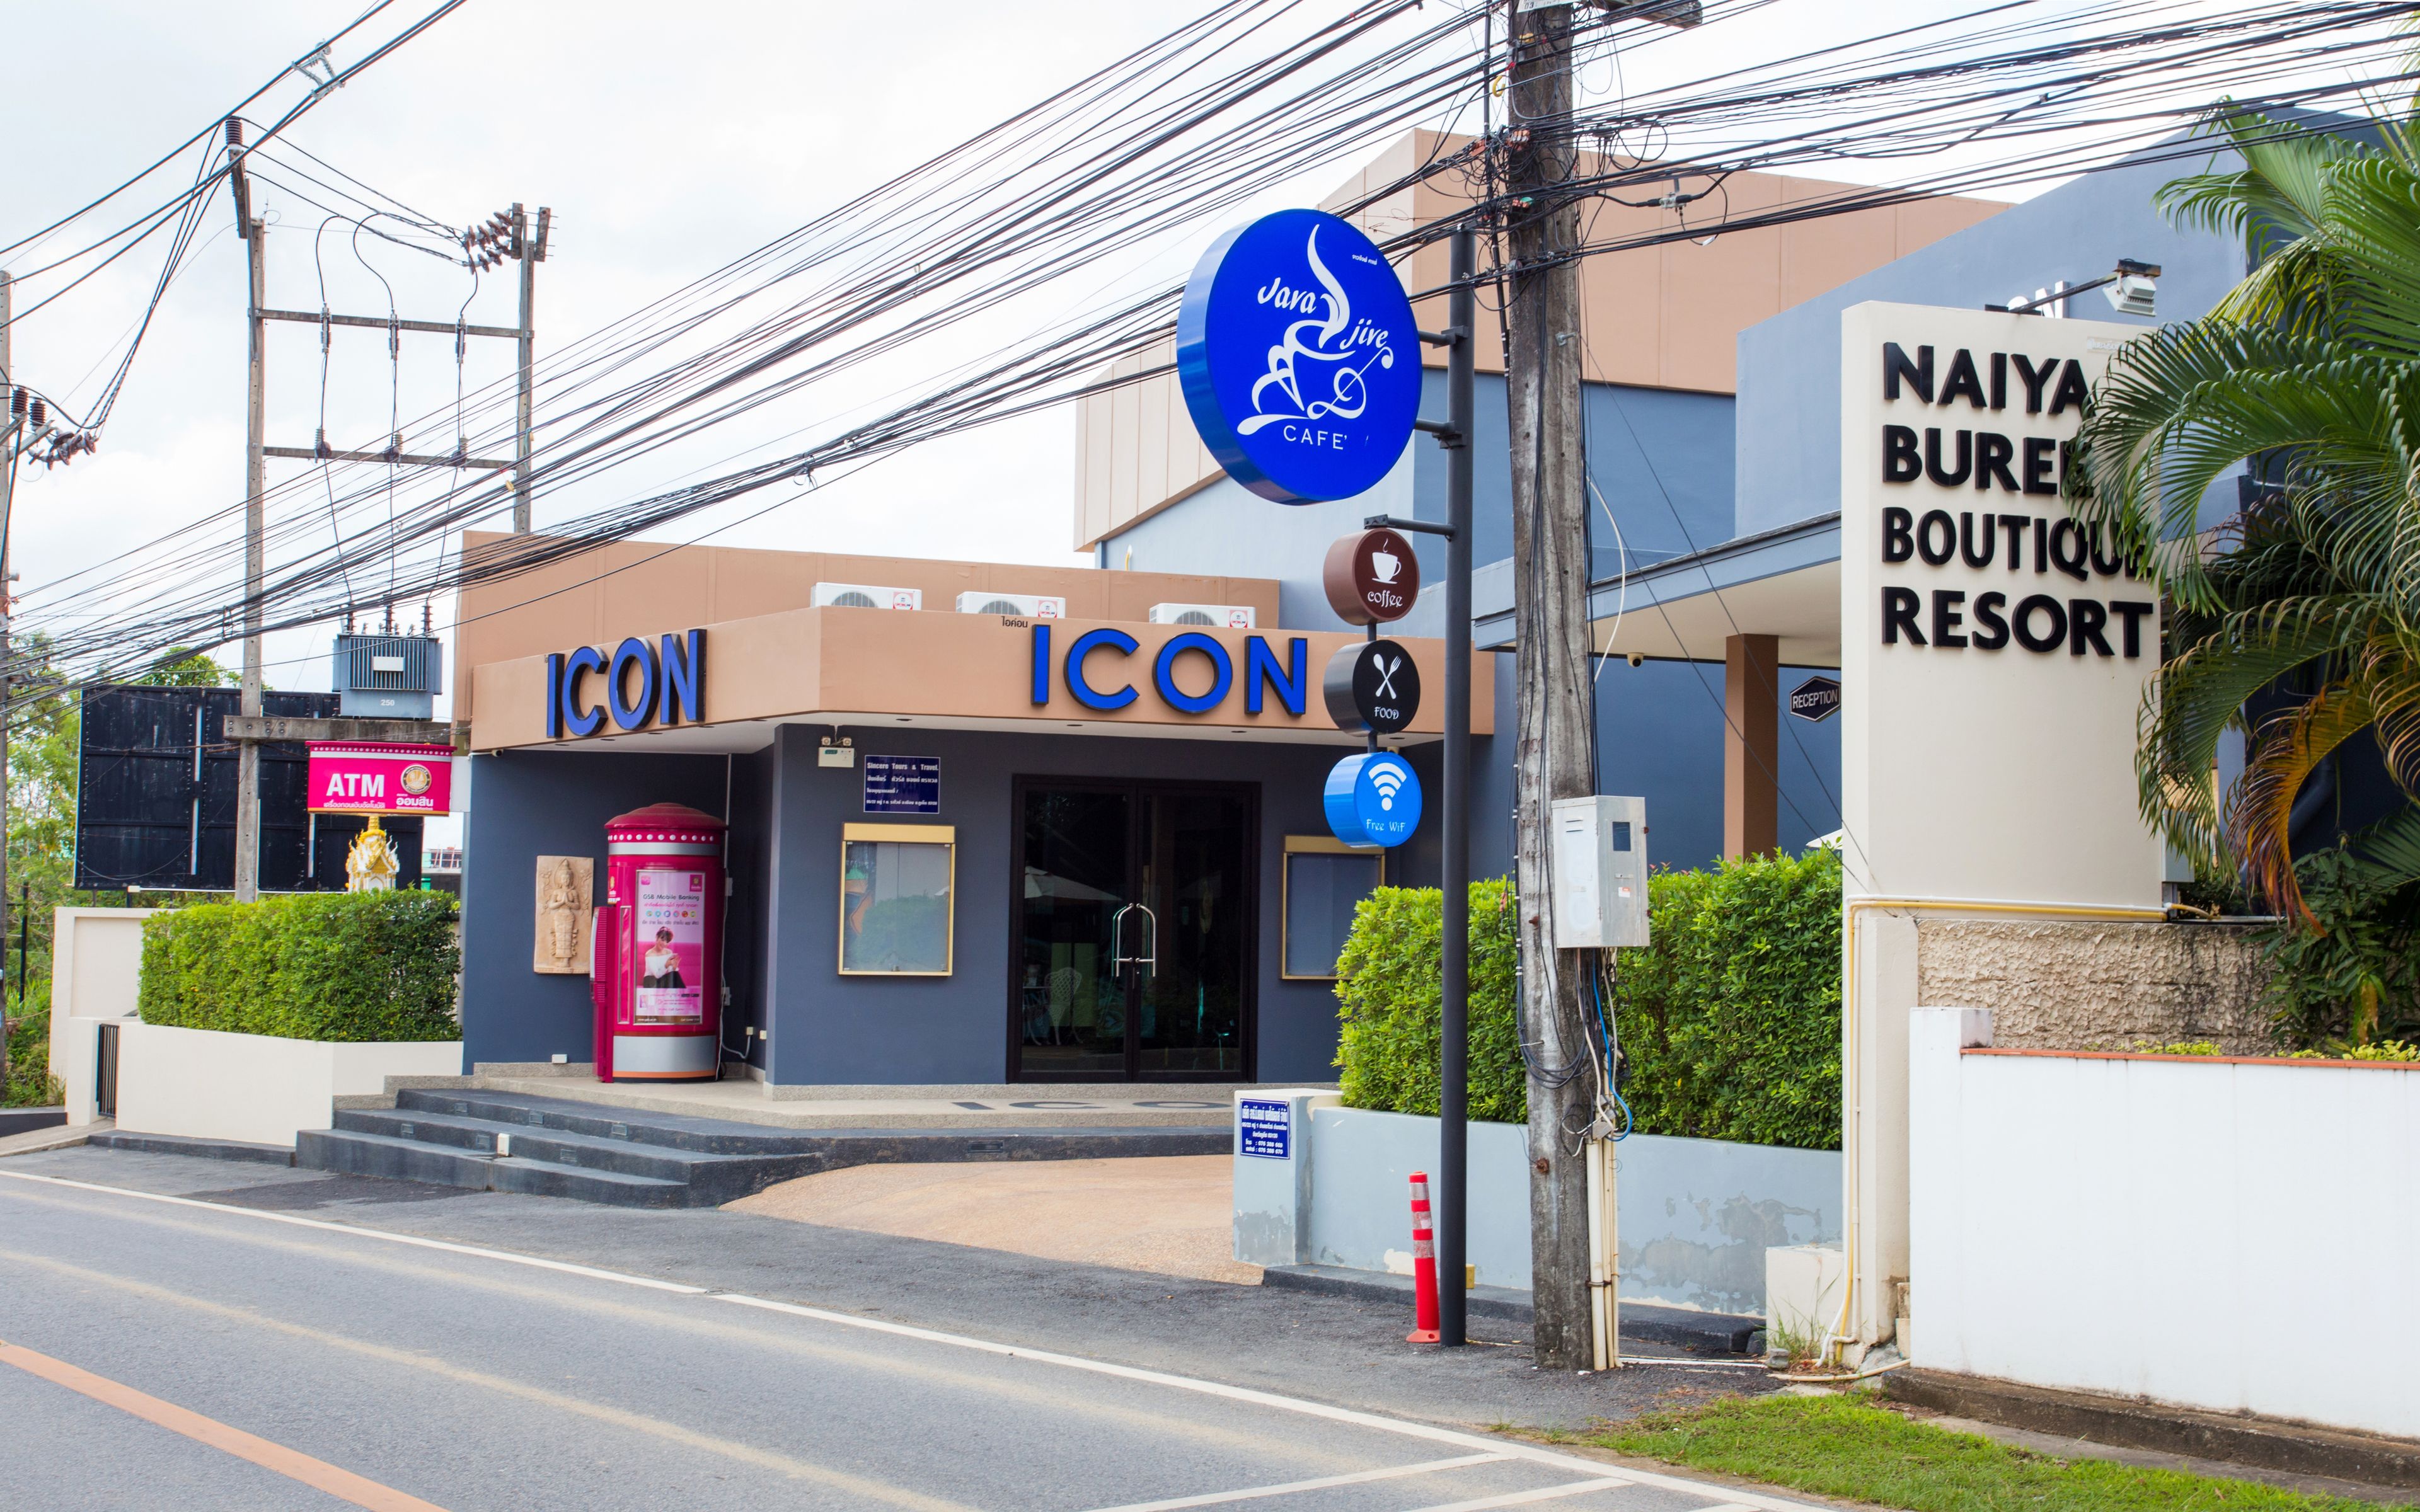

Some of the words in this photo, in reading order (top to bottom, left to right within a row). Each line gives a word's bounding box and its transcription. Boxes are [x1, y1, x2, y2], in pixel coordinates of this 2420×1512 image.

[1257, 277, 1317, 314] Java
[1340, 318, 1389, 350] jive
[1883, 341, 2096, 418] NAIYA
[1368, 590, 1403, 607] coffee
[1881, 586, 2153, 658] RESORT
[1030, 624, 1308, 716] ICON
[546, 628, 707, 739] ICON
[1792, 689, 1838, 709] RECEPTION
[1374, 706, 1399, 719] FOOD
[326, 773, 384, 797] ATM
[396, 796, 434, 807] ออมสิน
[1366, 819, 1385, 831] Free
[950, 1101, 1233, 1111] ICO
